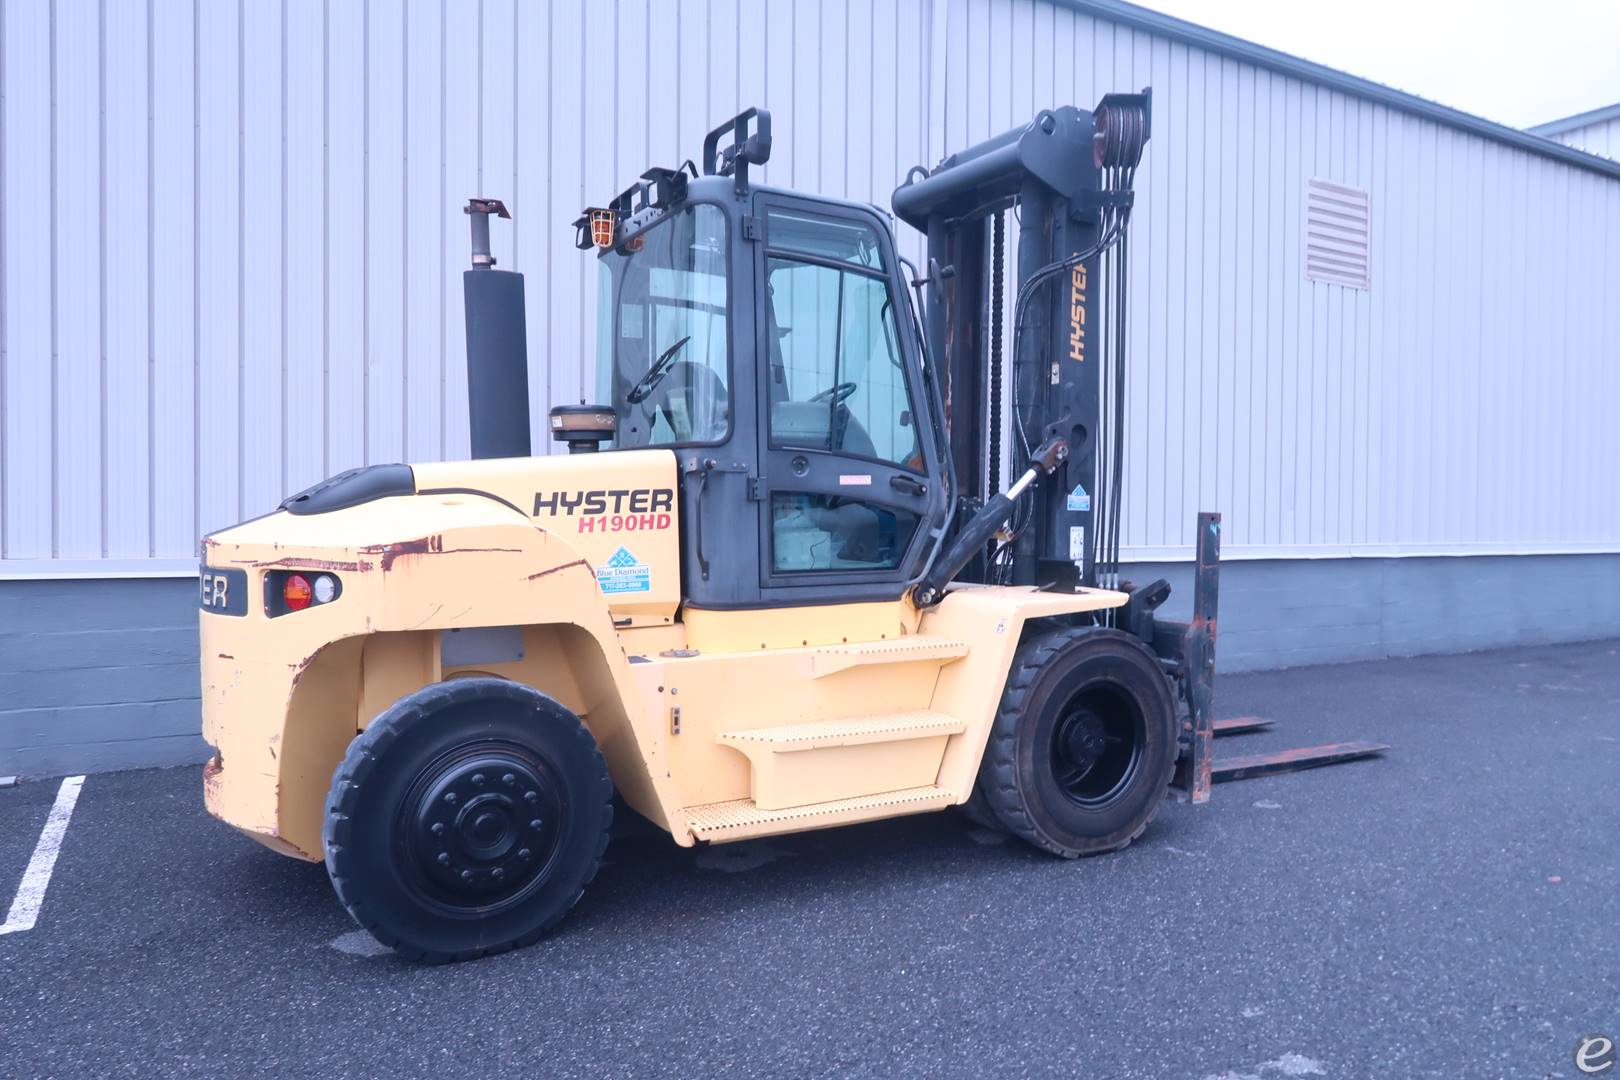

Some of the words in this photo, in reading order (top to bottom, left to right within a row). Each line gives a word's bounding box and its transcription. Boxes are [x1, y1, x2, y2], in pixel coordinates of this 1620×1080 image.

[533, 488, 673, 516] HYSTER
[578, 514, 671, 533] H190HD
[596, 567, 613, 577] Blue
[614, 567, 649, 576] Diamond
[200, 574, 228, 607] ER
